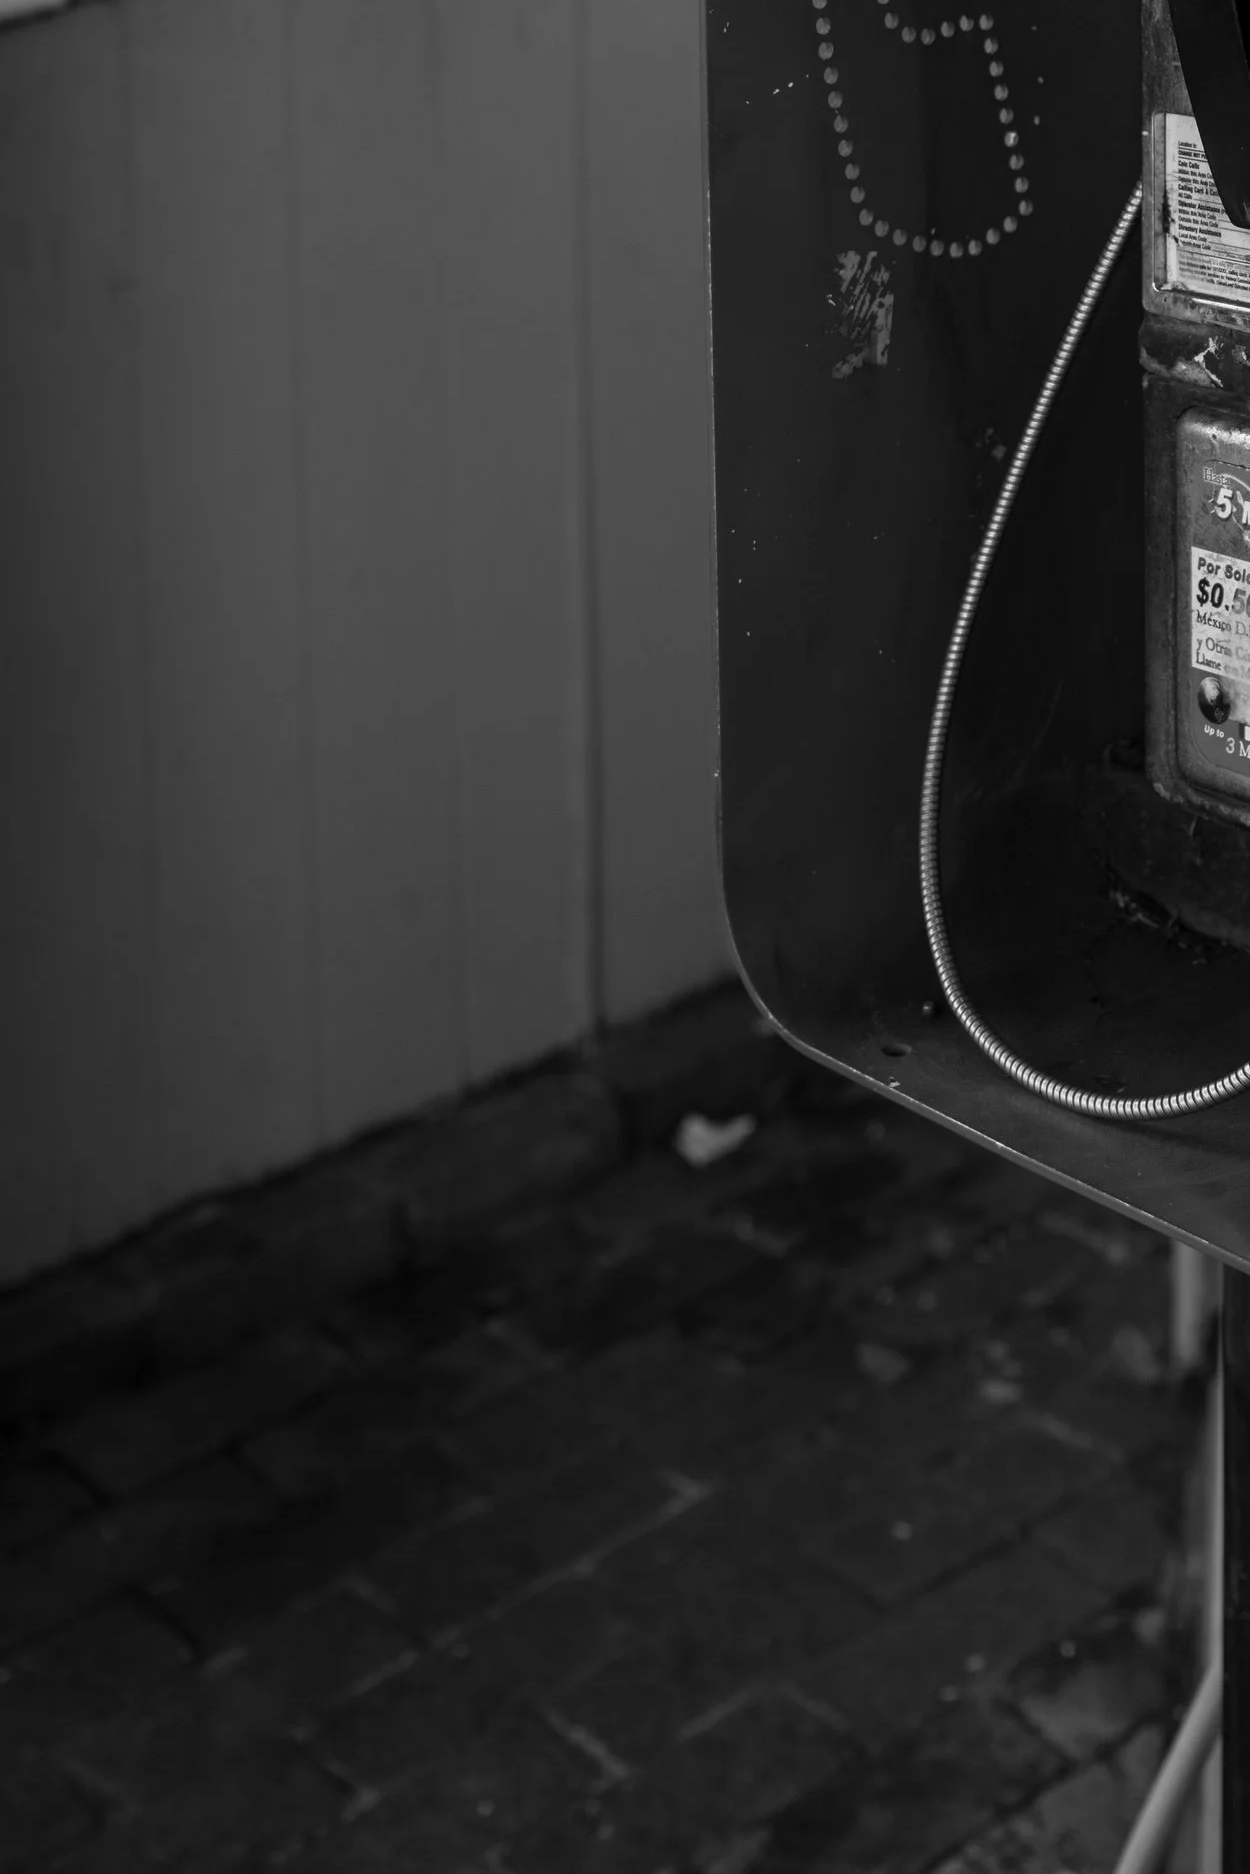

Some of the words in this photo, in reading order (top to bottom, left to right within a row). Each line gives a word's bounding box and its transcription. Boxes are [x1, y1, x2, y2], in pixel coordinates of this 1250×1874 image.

[1203, 467, 1231, 486] Hasta
[1215, 487, 1233, 519] 5
[1197, 556, 1221, 576] Por
[1196, 611, 1232, 632] México
[1197, 639, 1202, 650] y
[1205, 637, 1232, 657] Otras
[1196, 652, 1222, 671] Llame
[1204, 724, 1215, 736] Up
[1216, 729, 1225, 738] to
[1225, 737, 1236, 754] 3
